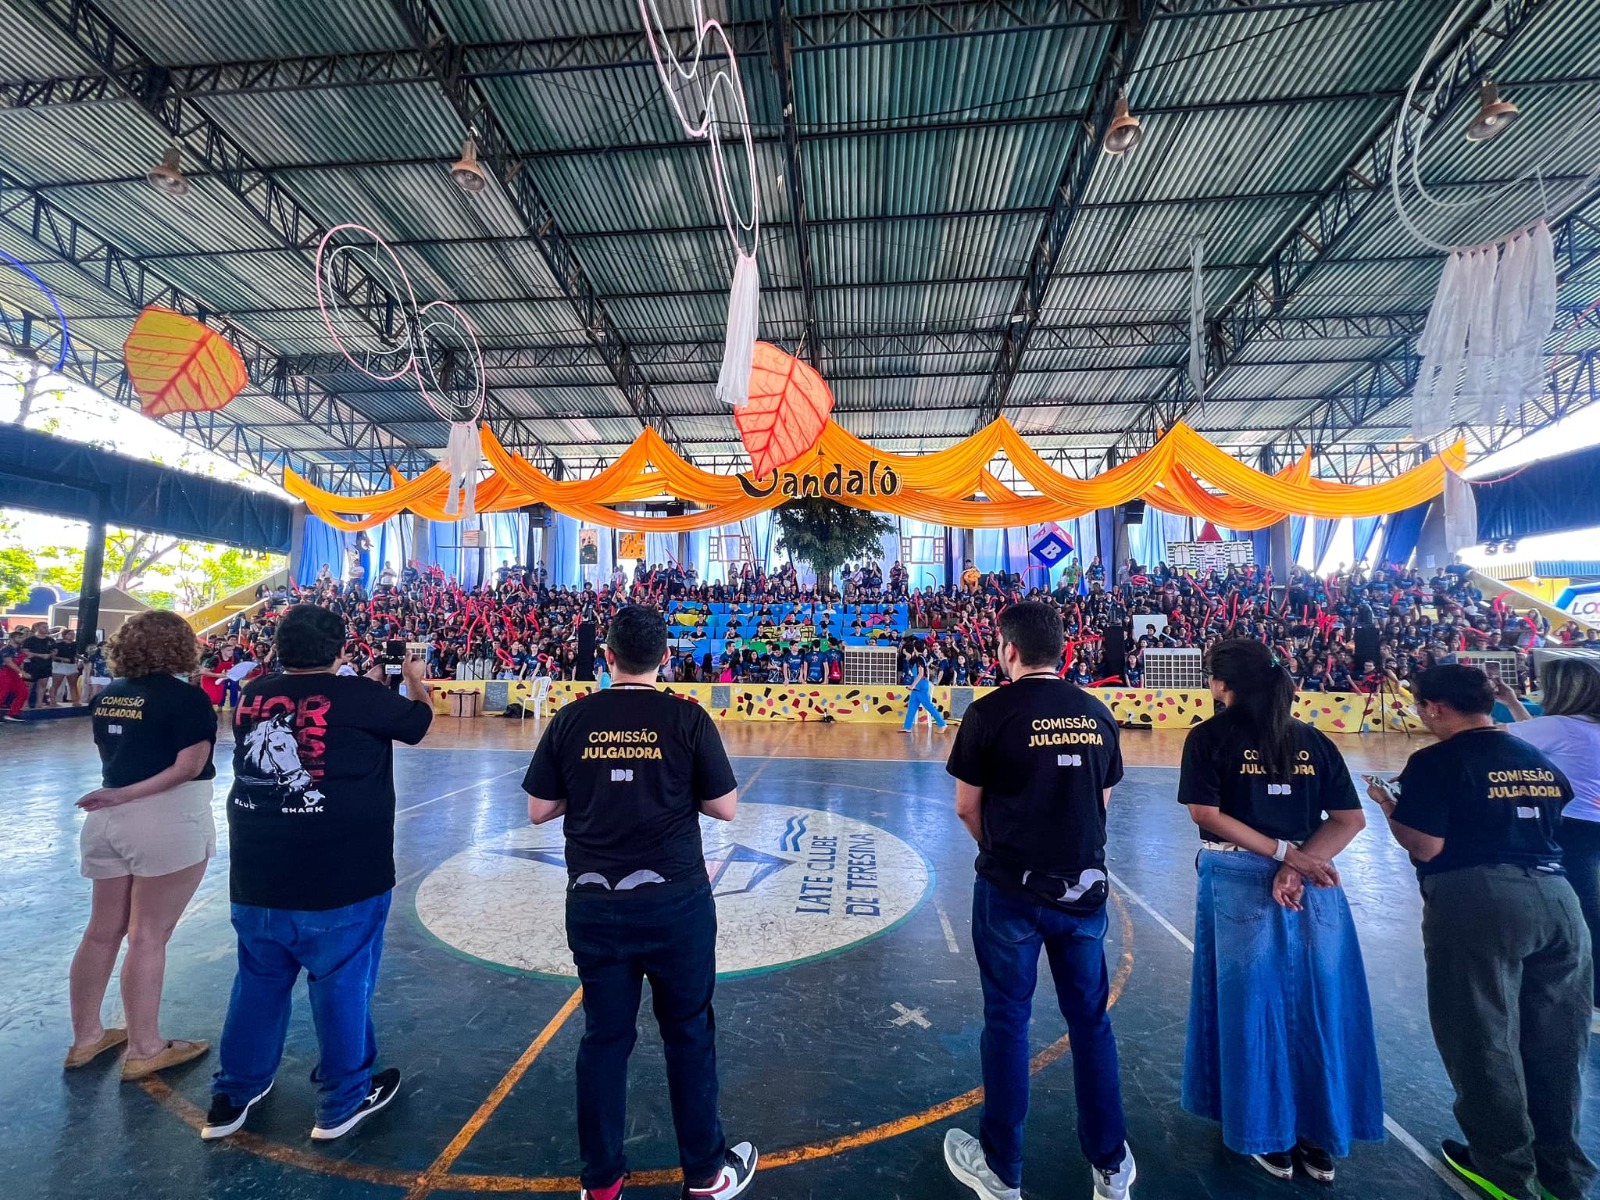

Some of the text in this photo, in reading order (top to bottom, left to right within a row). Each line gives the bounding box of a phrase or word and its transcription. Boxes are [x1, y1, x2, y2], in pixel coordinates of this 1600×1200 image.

[1039, 540, 1062, 560] B
[1572, 602, 1600, 615] LO
[101, 696, 145, 708] COMISSÃO
[94, 707, 143, 720] JULGADORA
[1031, 715, 1098, 731] COMISSÃO
[588, 728, 658, 744] COMISSÃO
[1028, 732, 1104, 747] JULGADORA
[581, 746, 663, 760] JULGADORA
[610, 769, 634, 782] IDB
[1488, 767, 1555, 783] COMISSÃO
[1487, 785, 1562, 799] JULGADORA
[281, 805, 324, 814] SHARK
[795, 835, 838, 915] IATE CLUBE
[845, 833, 880, 917] DE TERESINA
